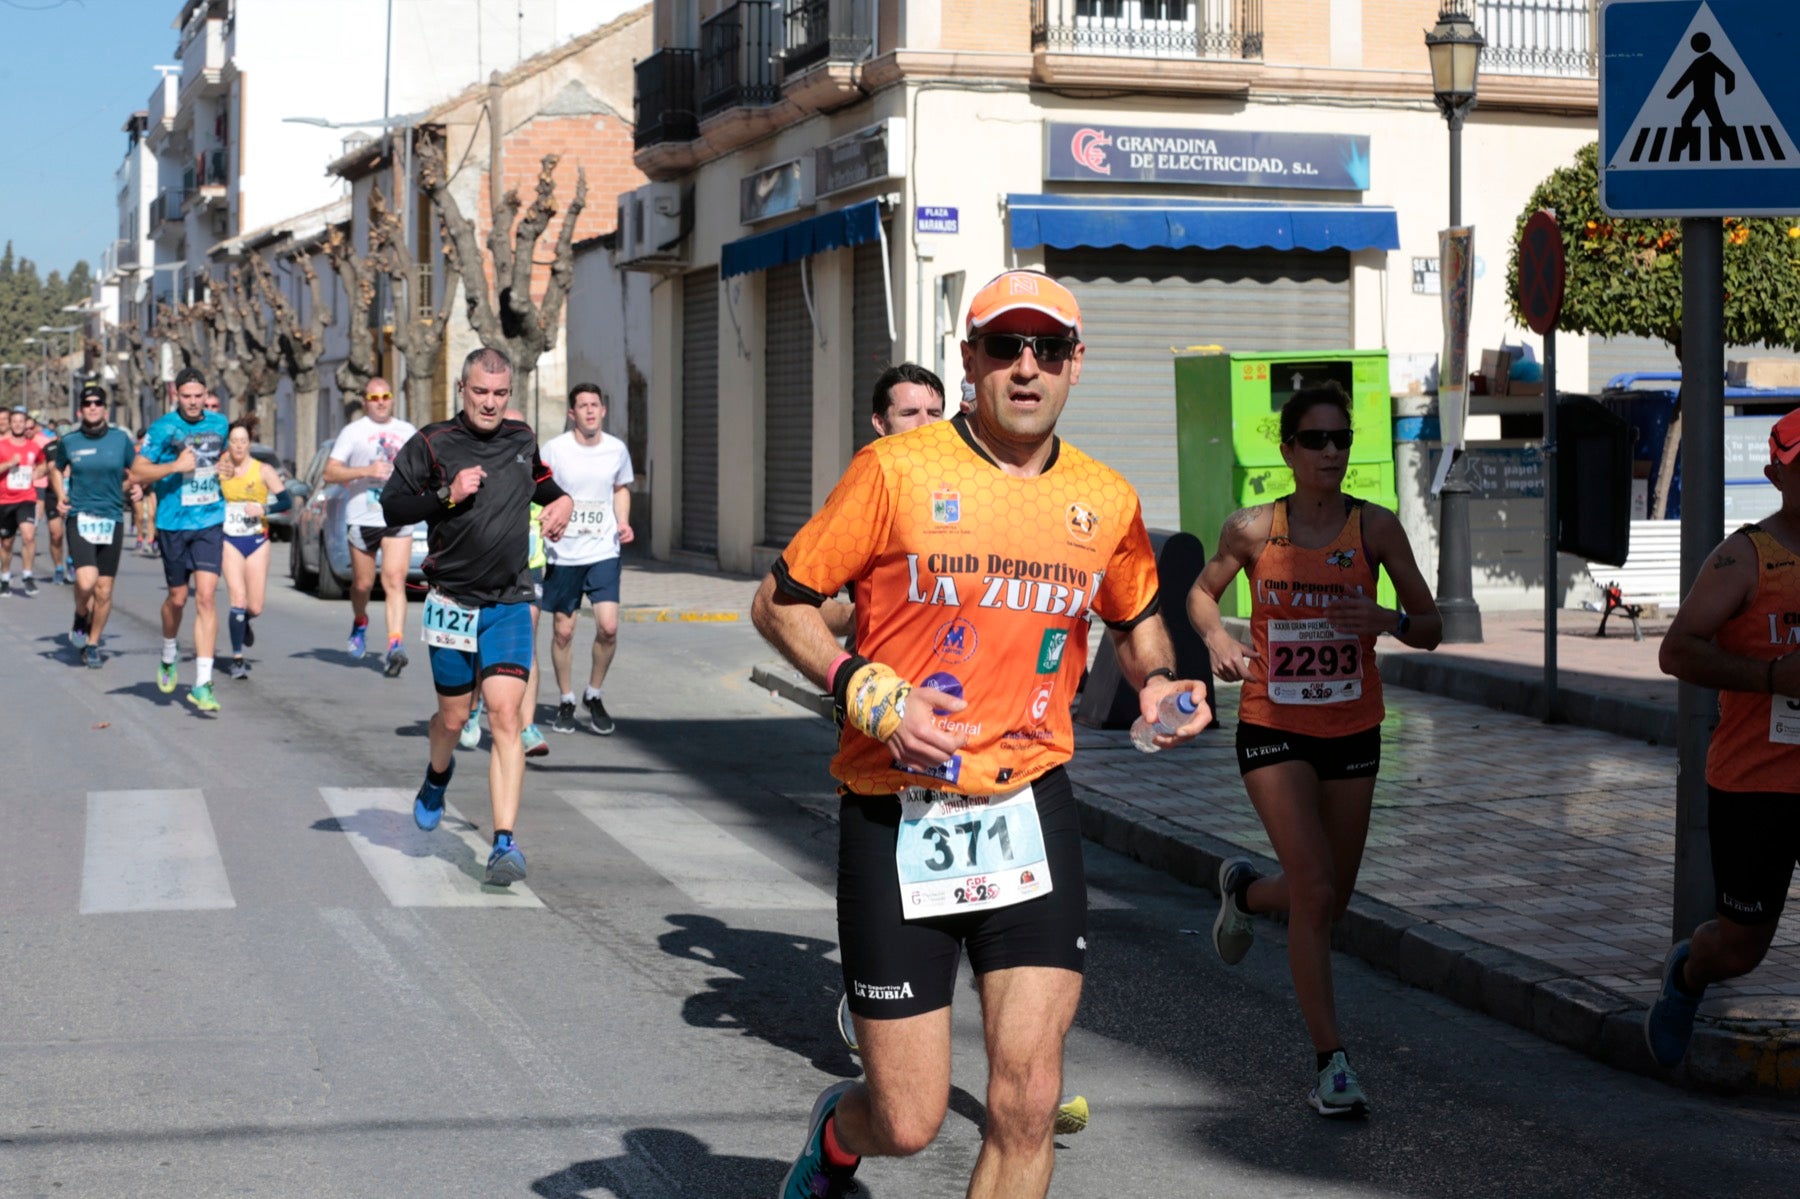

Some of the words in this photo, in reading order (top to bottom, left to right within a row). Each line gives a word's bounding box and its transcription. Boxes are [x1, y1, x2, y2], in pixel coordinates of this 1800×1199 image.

[1116, 135, 1218, 155] GRANADINA
[1130, 152, 1154, 169] DE
[1157, 155, 1288, 176] ELECTRICIDAD,
[1292, 162, 1319, 176] S.L.
[925, 208, 949, 217] PLAZA
[919, 219, 957, 232] NARANJOS
[1482, 464, 1497, 475] Tu
[1504, 463, 1538, 477] papel
[191, 478, 215, 493] 940
[570, 511, 604, 524] 3150
[906, 552, 961, 606] LA
[927, 552, 980, 574] Club
[987, 553, 1087, 587] Deportivo
[1265, 579, 1289, 590] Club
[1292, 580, 1345, 593] Deportiv
[426, 604, 475, 632] 1127
[1291, 622, 1306, 630] GRAN
[1274, 644, 1358, 677] 2293
[938, 717, 982, 736] dental
[922, 815, 1014, 872] 371
[853, 979, 866, 998] LA
[868, 981, 915, 1000] ZUBIA
